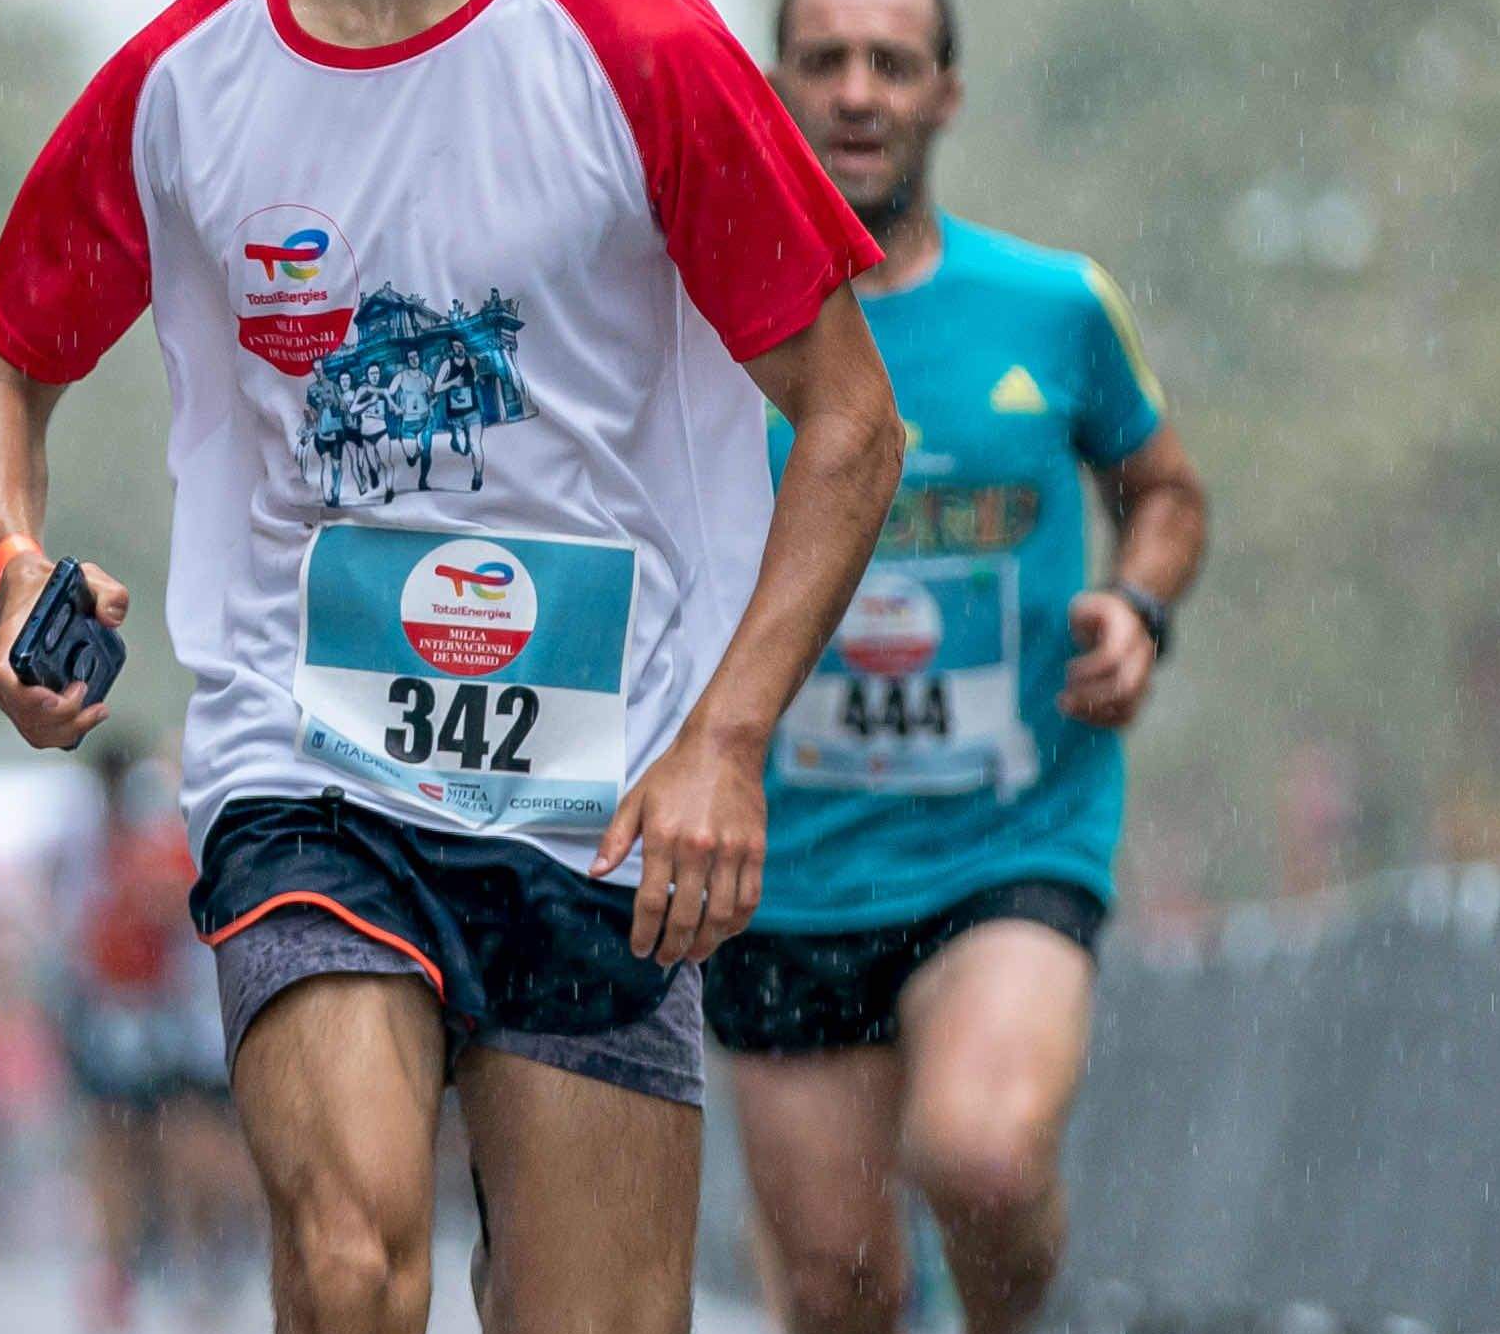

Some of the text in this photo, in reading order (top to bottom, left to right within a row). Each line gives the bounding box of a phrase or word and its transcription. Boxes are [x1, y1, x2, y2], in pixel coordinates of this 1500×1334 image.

[432, 603, 512, 620] TotalEnergies
[448, 627, 487, 642] MILLA
[419, 637, 515, 656] INTERNACIONAL
[432, 651, 500, 666] DE MADRID
[844, 677, 949, 737] 444
[384, 676, 540, 773] 342
